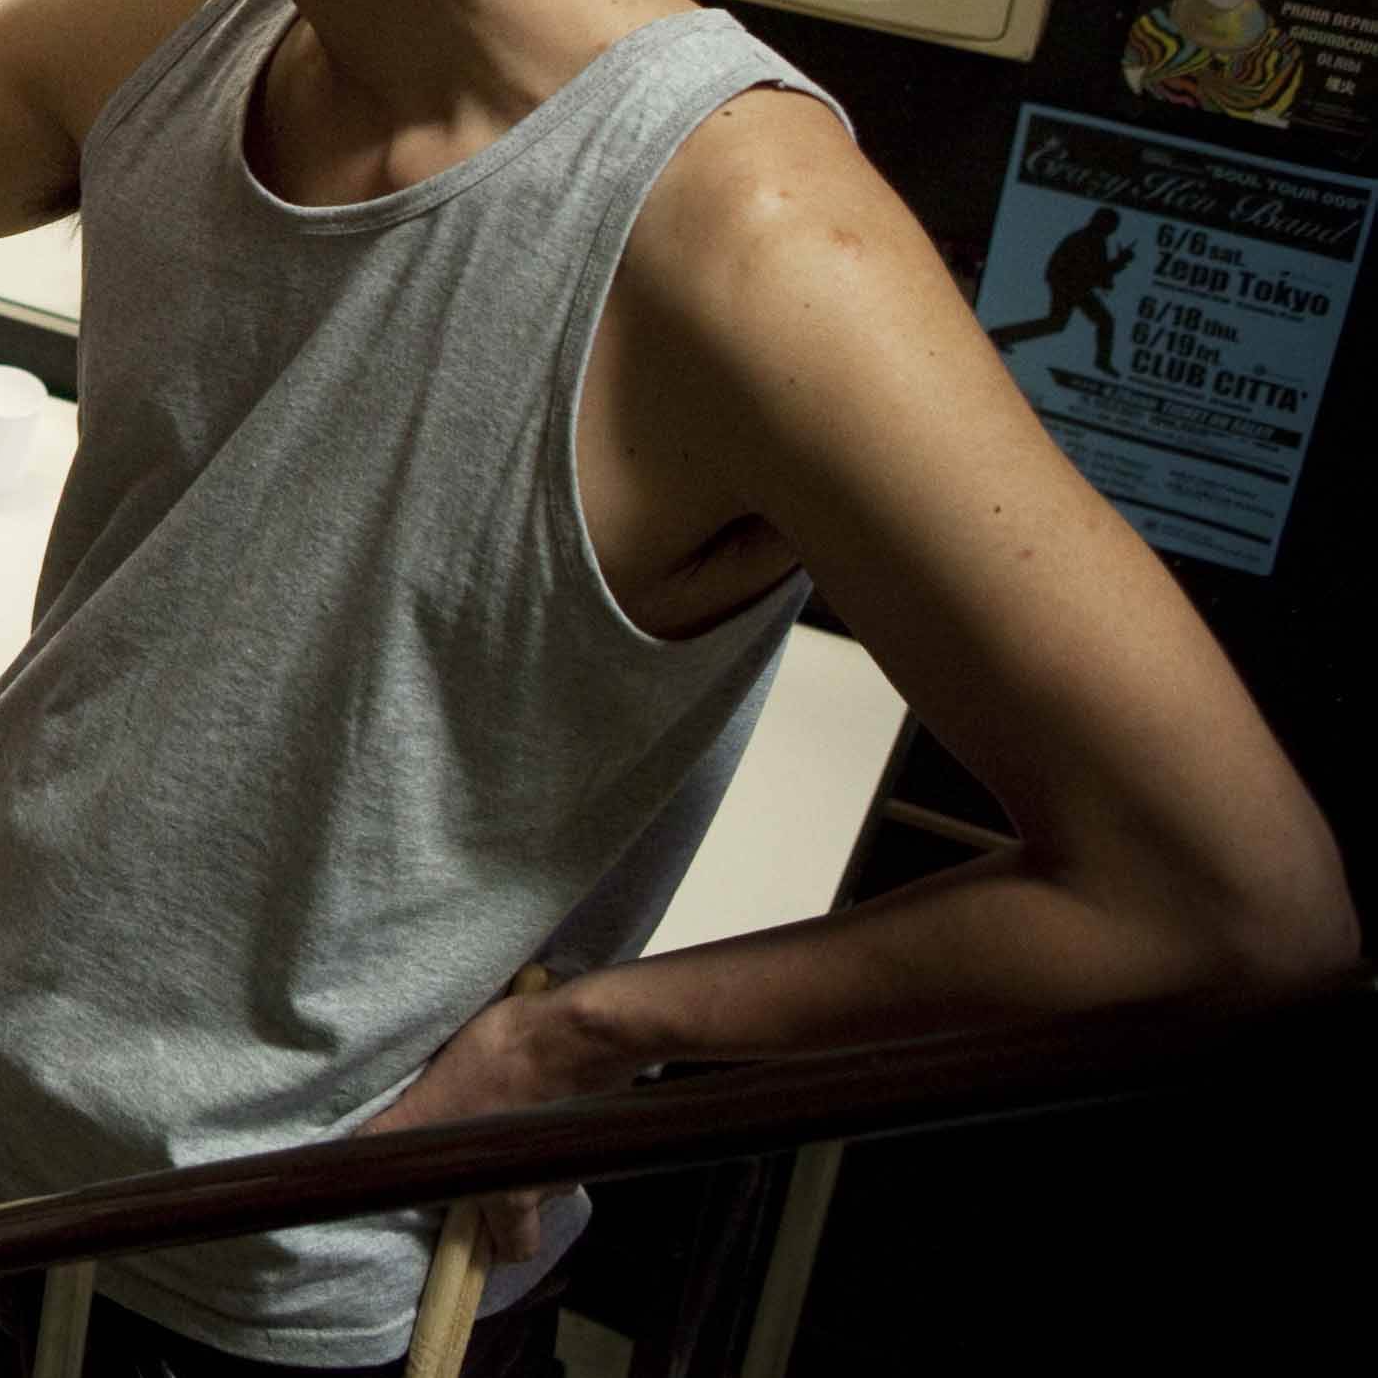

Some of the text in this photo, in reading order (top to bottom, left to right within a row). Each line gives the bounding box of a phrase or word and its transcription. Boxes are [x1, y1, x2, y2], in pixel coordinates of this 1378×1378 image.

[1154, 251, 1330, 317] Zepp Tokyo
[1131, 348, 1208, 388] CLUB
